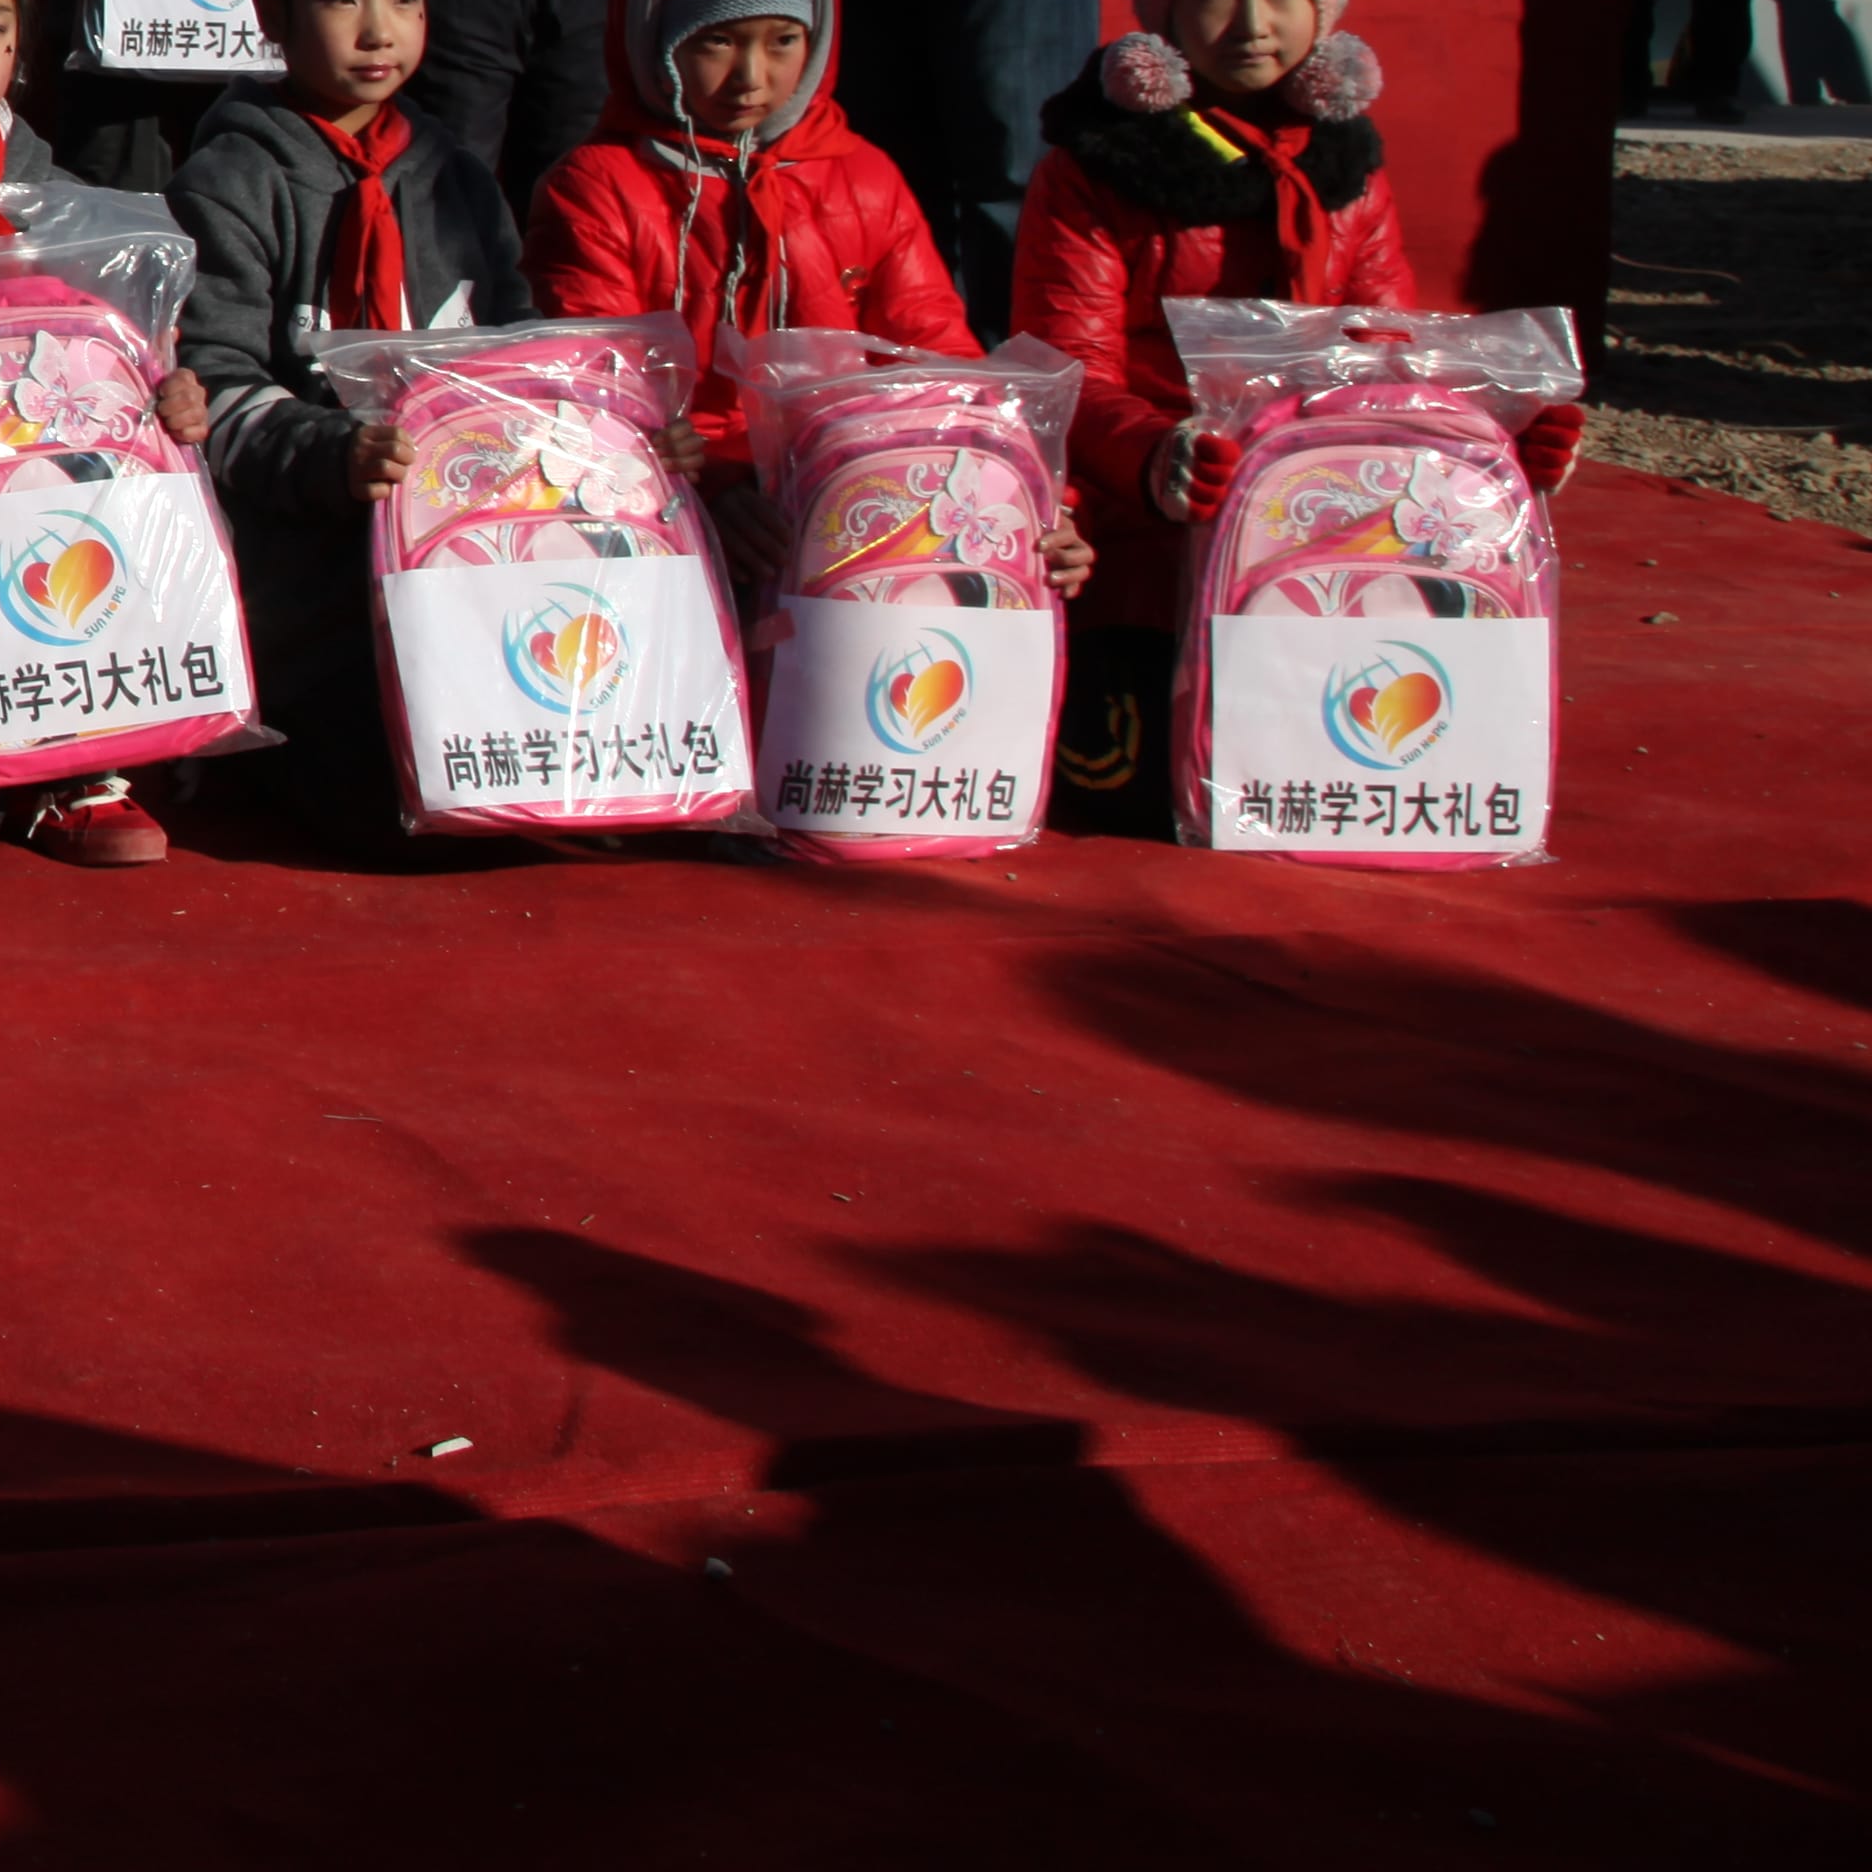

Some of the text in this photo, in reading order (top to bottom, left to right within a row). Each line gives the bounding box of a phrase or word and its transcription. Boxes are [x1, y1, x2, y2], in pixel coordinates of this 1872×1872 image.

[441, 720, 725, 793] 尚赫学习大礼包
[776, 759, 1018, 823] 尚赫学习大礼包
[1238, 779, 1523, 838] 尚赫学习大礼包
